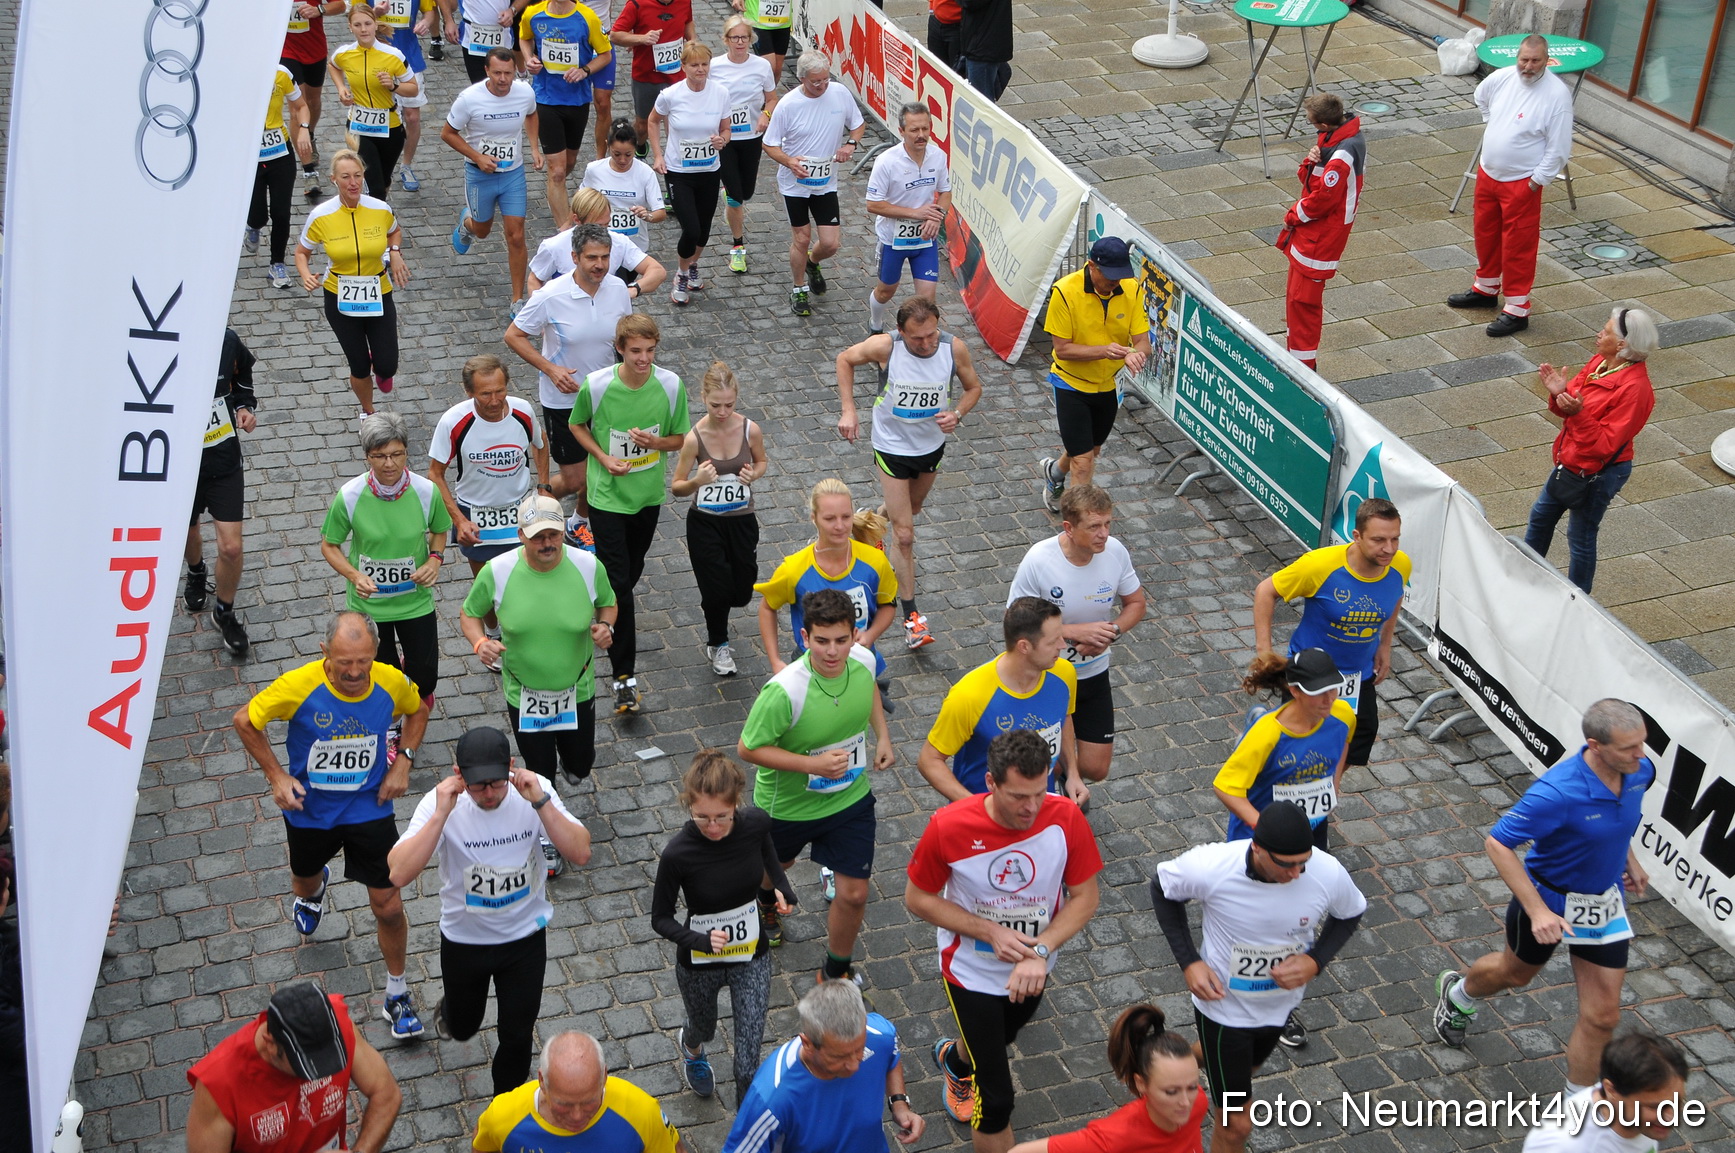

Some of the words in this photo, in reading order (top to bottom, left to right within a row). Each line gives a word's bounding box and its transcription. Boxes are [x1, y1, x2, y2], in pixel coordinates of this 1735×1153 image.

[765, 5, 785, 16] 297
[473, 32, 502, 45] 2719
[548, 50, 572, 63] 645
[355, 109, 386, 125] 2778
[482, 145, 514, 159] 2454
[684, 145, 715, 159] 2716
[342, 286, 378, 301] 2714
[1205, 325, 1275, 393] Event-Leit-Systeme
[118, 275, 184, 483] BKK
[897, 391, 940, 408] 2788
[1183, 346, 1216, 387] Mehr
[1216, 375, 1275, 443] Sicherheit
[1181, 372, 1199, 401] für
[1200, 389, 1217, 418] Ihr
[1218, 407, 1257, 456] Event!
[611, 432, 628, 441] PARTL
[468, 450, 516, 460] GERHART
[1178, 408, 1195, 431] Miet
[1195, 424, 1203, 437] &
[1202, 430, 1228, 461] Service
[1228, 453, 1246, 479] Line:
[1246, 471, 1269, 500] 09181
[1269, 493, 1289, 519] 6352
[703, 485, 746, 502] 2764
[476, 508, 518, 528] 3353
[364, 566, 411, 583] 2366
[87, 527, 163, 750] Audi
[1483, 685, 1500, 706] die
[1500, 700, 1549, 756] verbinden
[314, 749, 371, 770] 2466
[326, 774, 356, 783] Rudolf
[463, 830, 533, 848] www.hasit.de
[1632, 812, 1734, 922] twerke
[716, 912, 748, 922] Neumarkt
[976, 908, 1001, 918] PARTL
